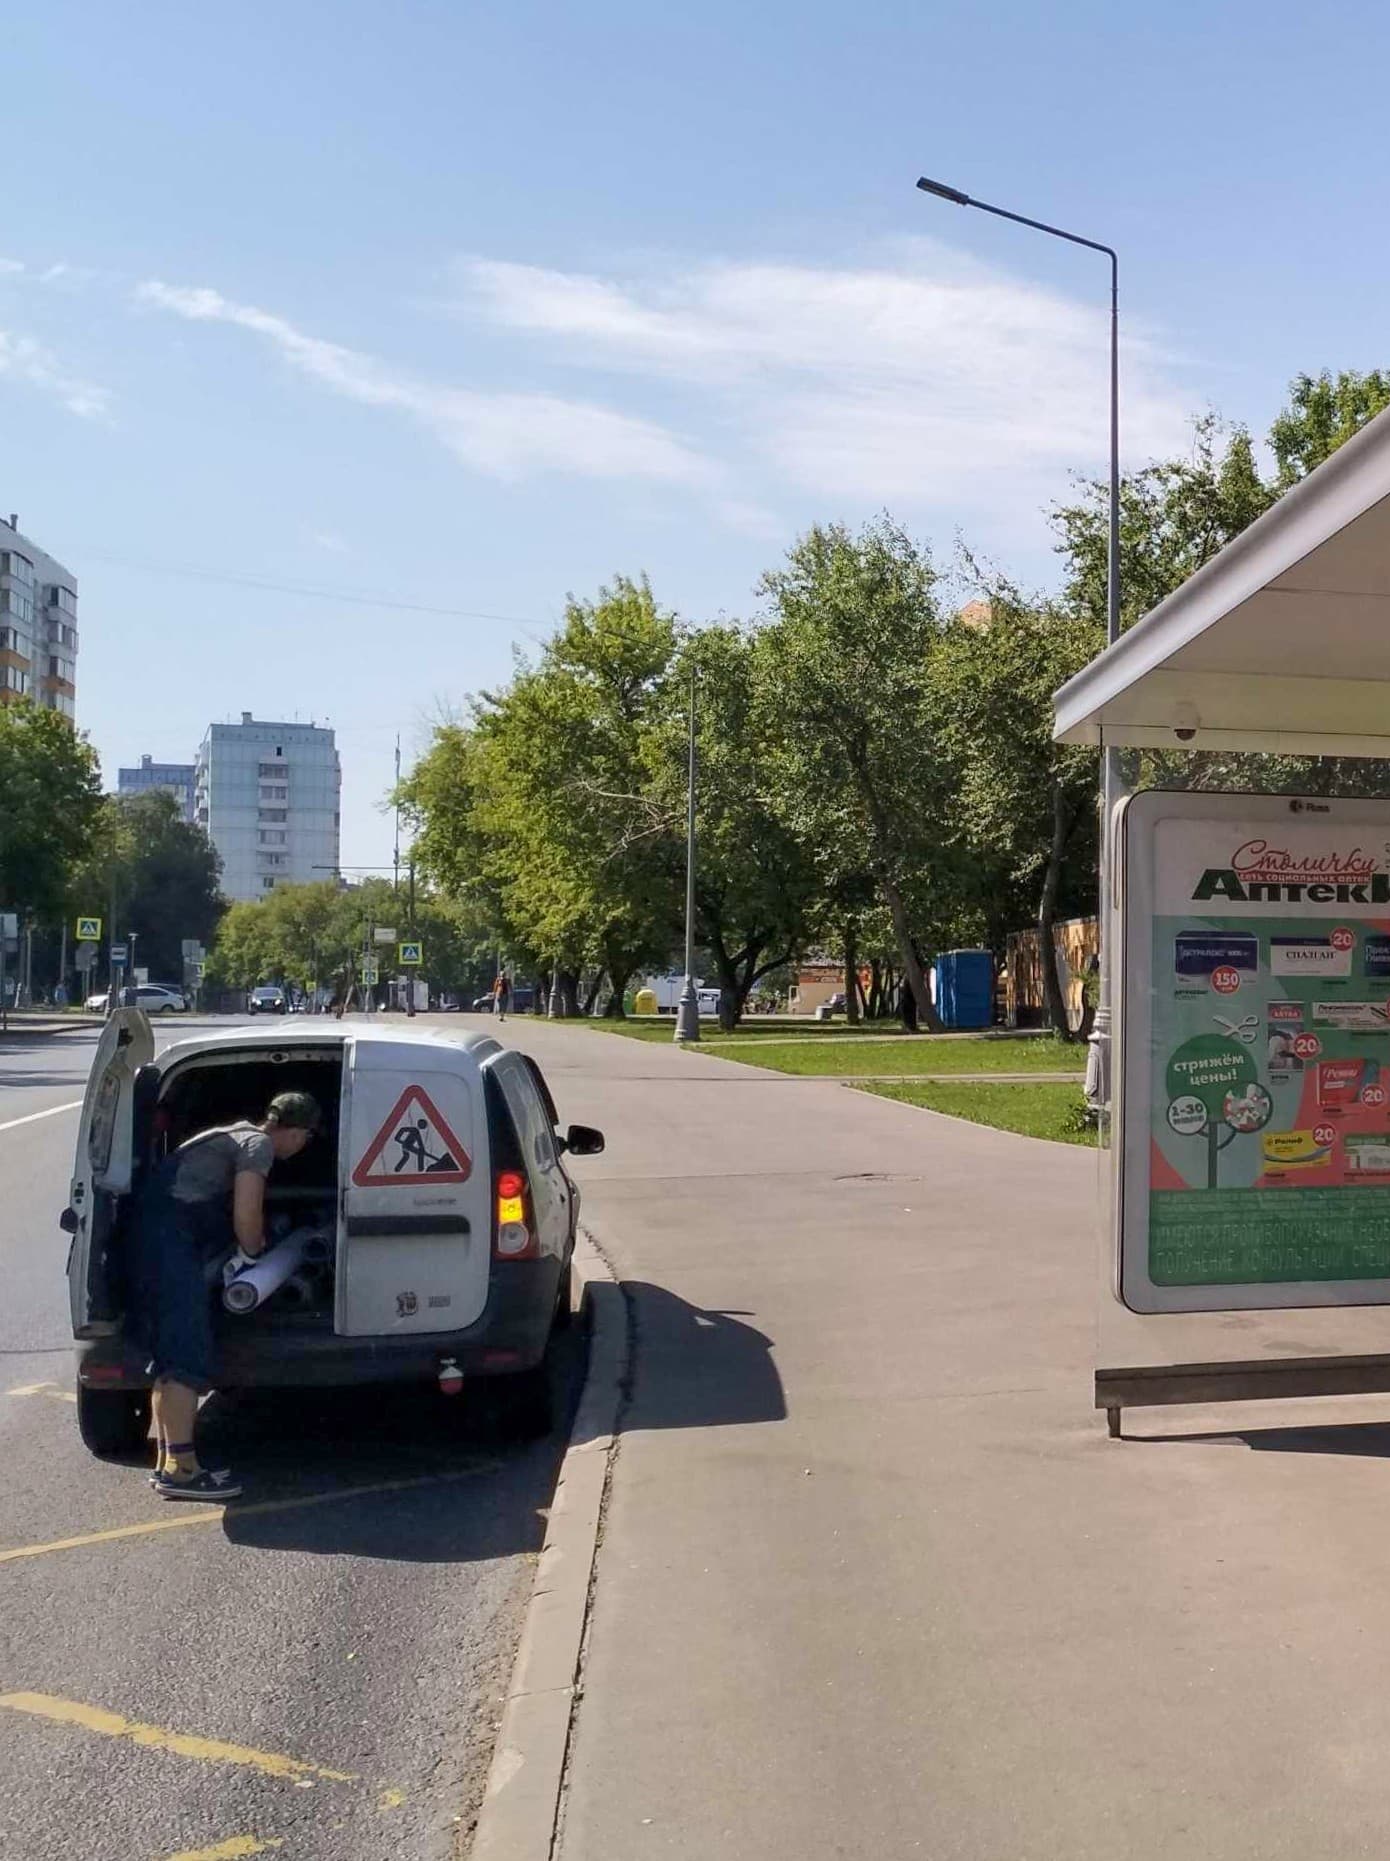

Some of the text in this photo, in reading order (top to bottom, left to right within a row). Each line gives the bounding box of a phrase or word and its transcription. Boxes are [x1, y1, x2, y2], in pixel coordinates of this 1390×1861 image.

[1231, 839, 1381, 873] Столички
[1240, 872, 1370, 883] сеть социальных аптек
[1333, 932, 1351, 946] 20
[1216, 972, 1239, 986] 150
[1296, 1038, 1317, 1053] 20
[1174, 1053, 1245, 1074] стрижём
[1190, 1068, 1238, 1086] цены!
[1364, 1089, 1383, 1103] 20
[1314, 1127, 1334, 1141] 20
